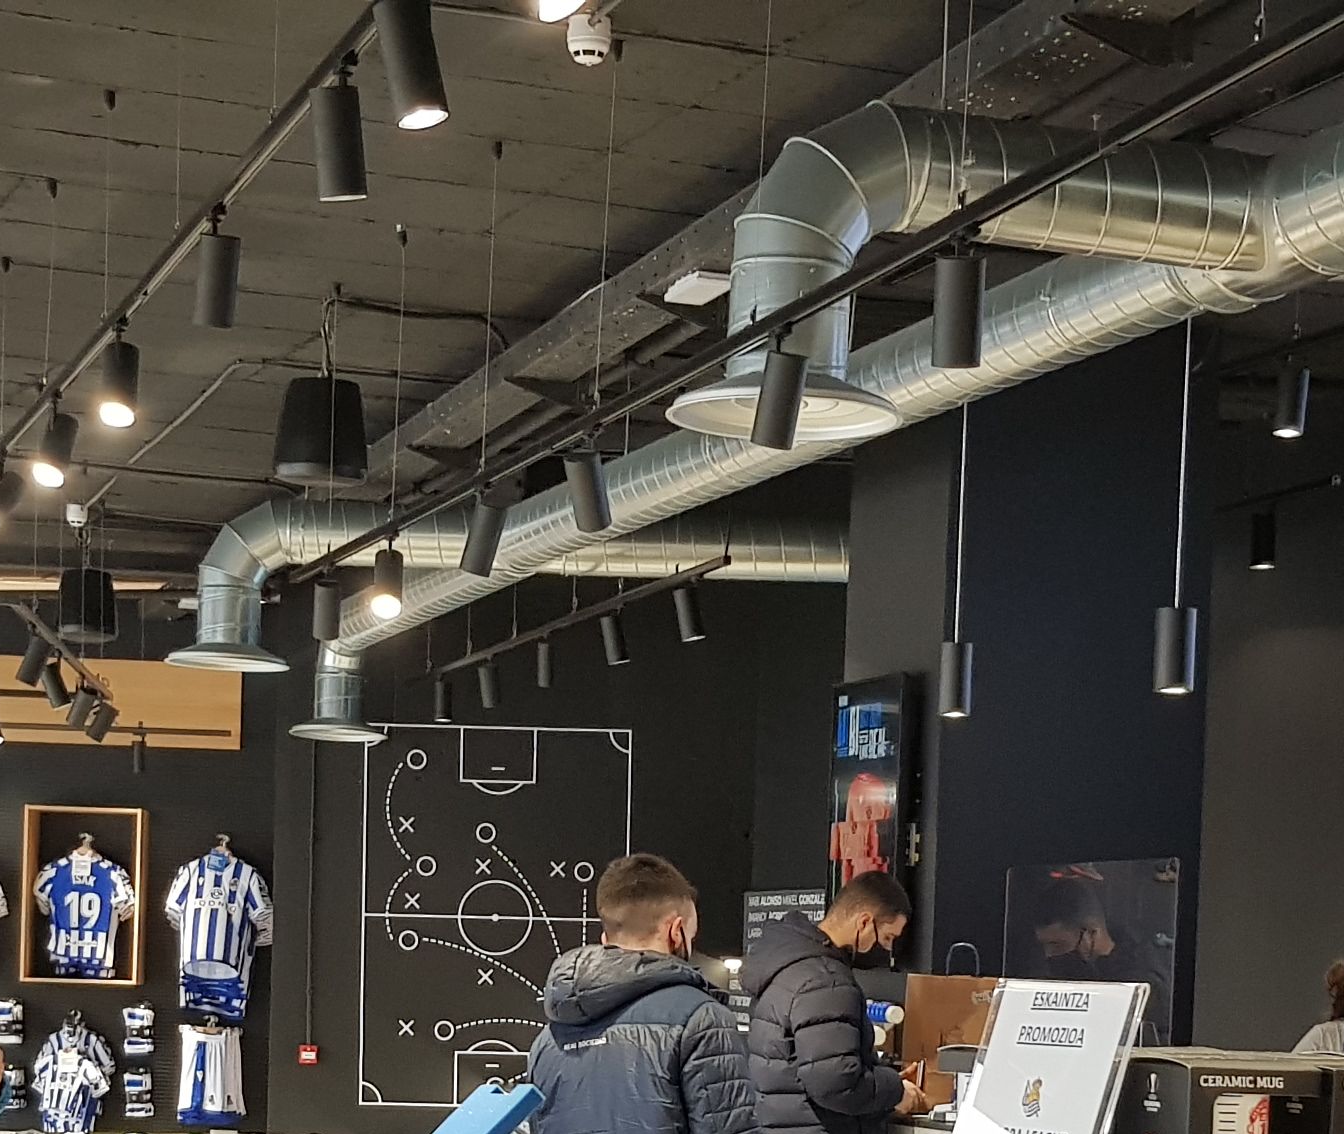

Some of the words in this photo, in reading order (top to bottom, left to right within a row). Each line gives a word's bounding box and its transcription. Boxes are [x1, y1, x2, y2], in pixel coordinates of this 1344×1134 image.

[64, 891, 101, 929] 19
[1032, 991, 1090, 1009] ESKAINTZA
[1017, 1025, 1085, 1044] PROMOZIOA
[1199, 1075, 1255, 1089] CERAMIC
[1256, 1076, 1284, 1090] MUG
